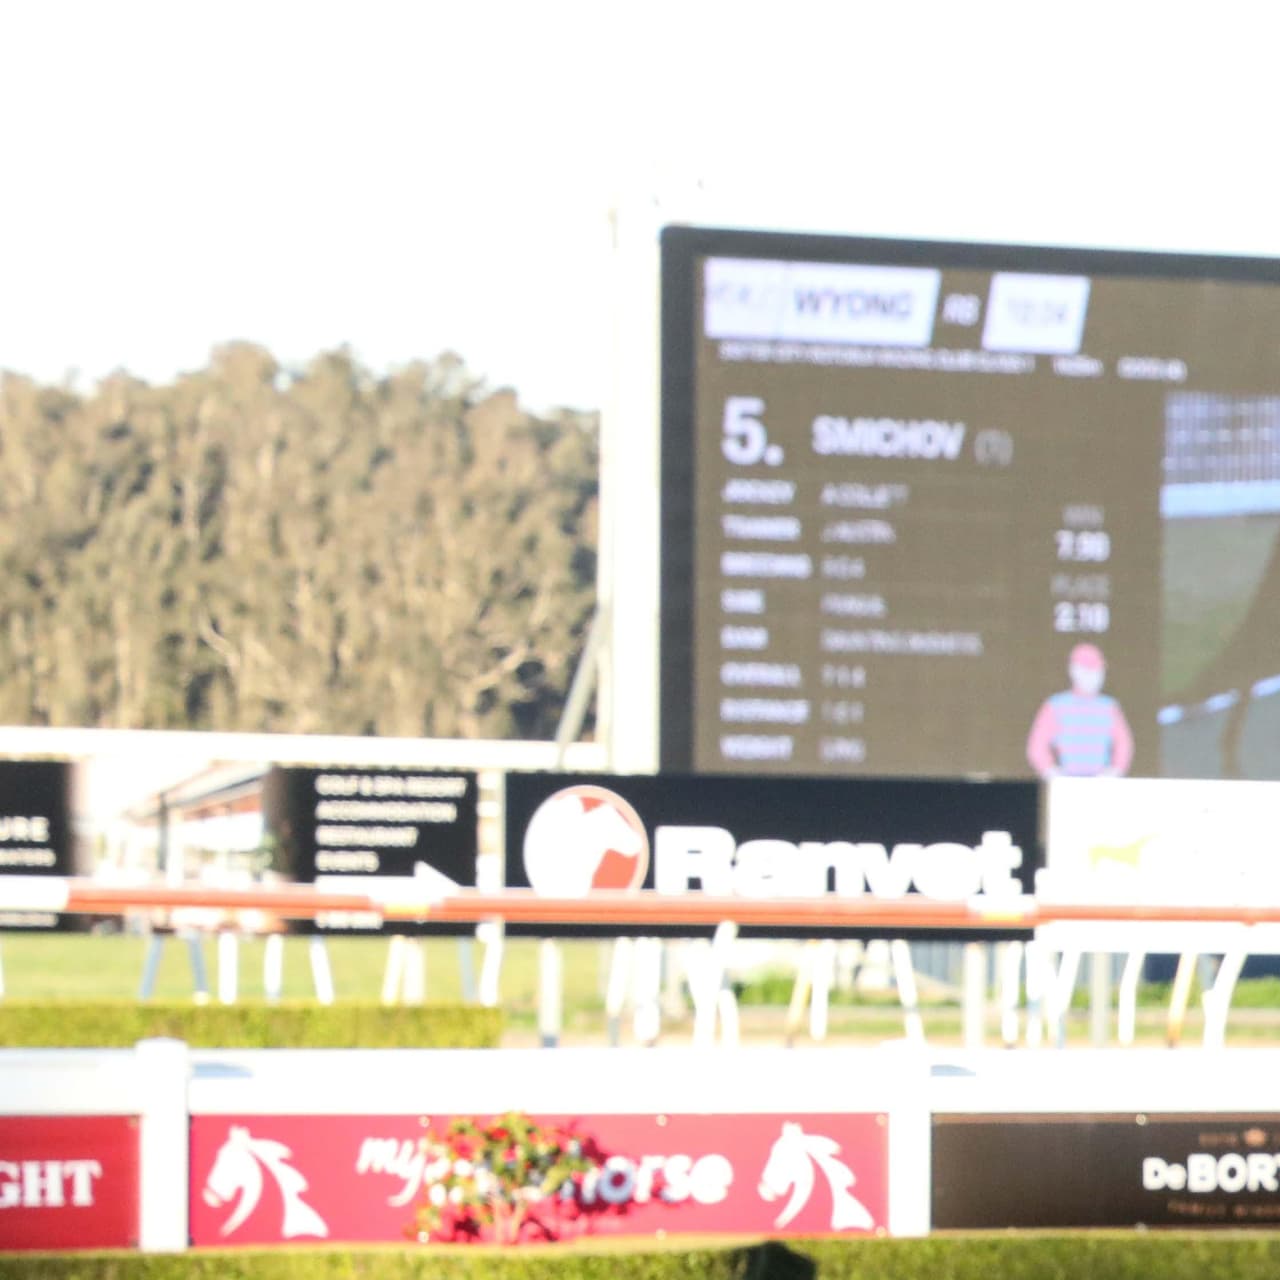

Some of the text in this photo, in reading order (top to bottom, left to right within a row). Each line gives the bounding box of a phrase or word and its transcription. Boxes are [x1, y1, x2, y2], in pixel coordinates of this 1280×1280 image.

[795, 288, 913, 320] WYONG
[721, 395, 784, 468] 5.
[811, 414, 966, 459] SMICHOV
